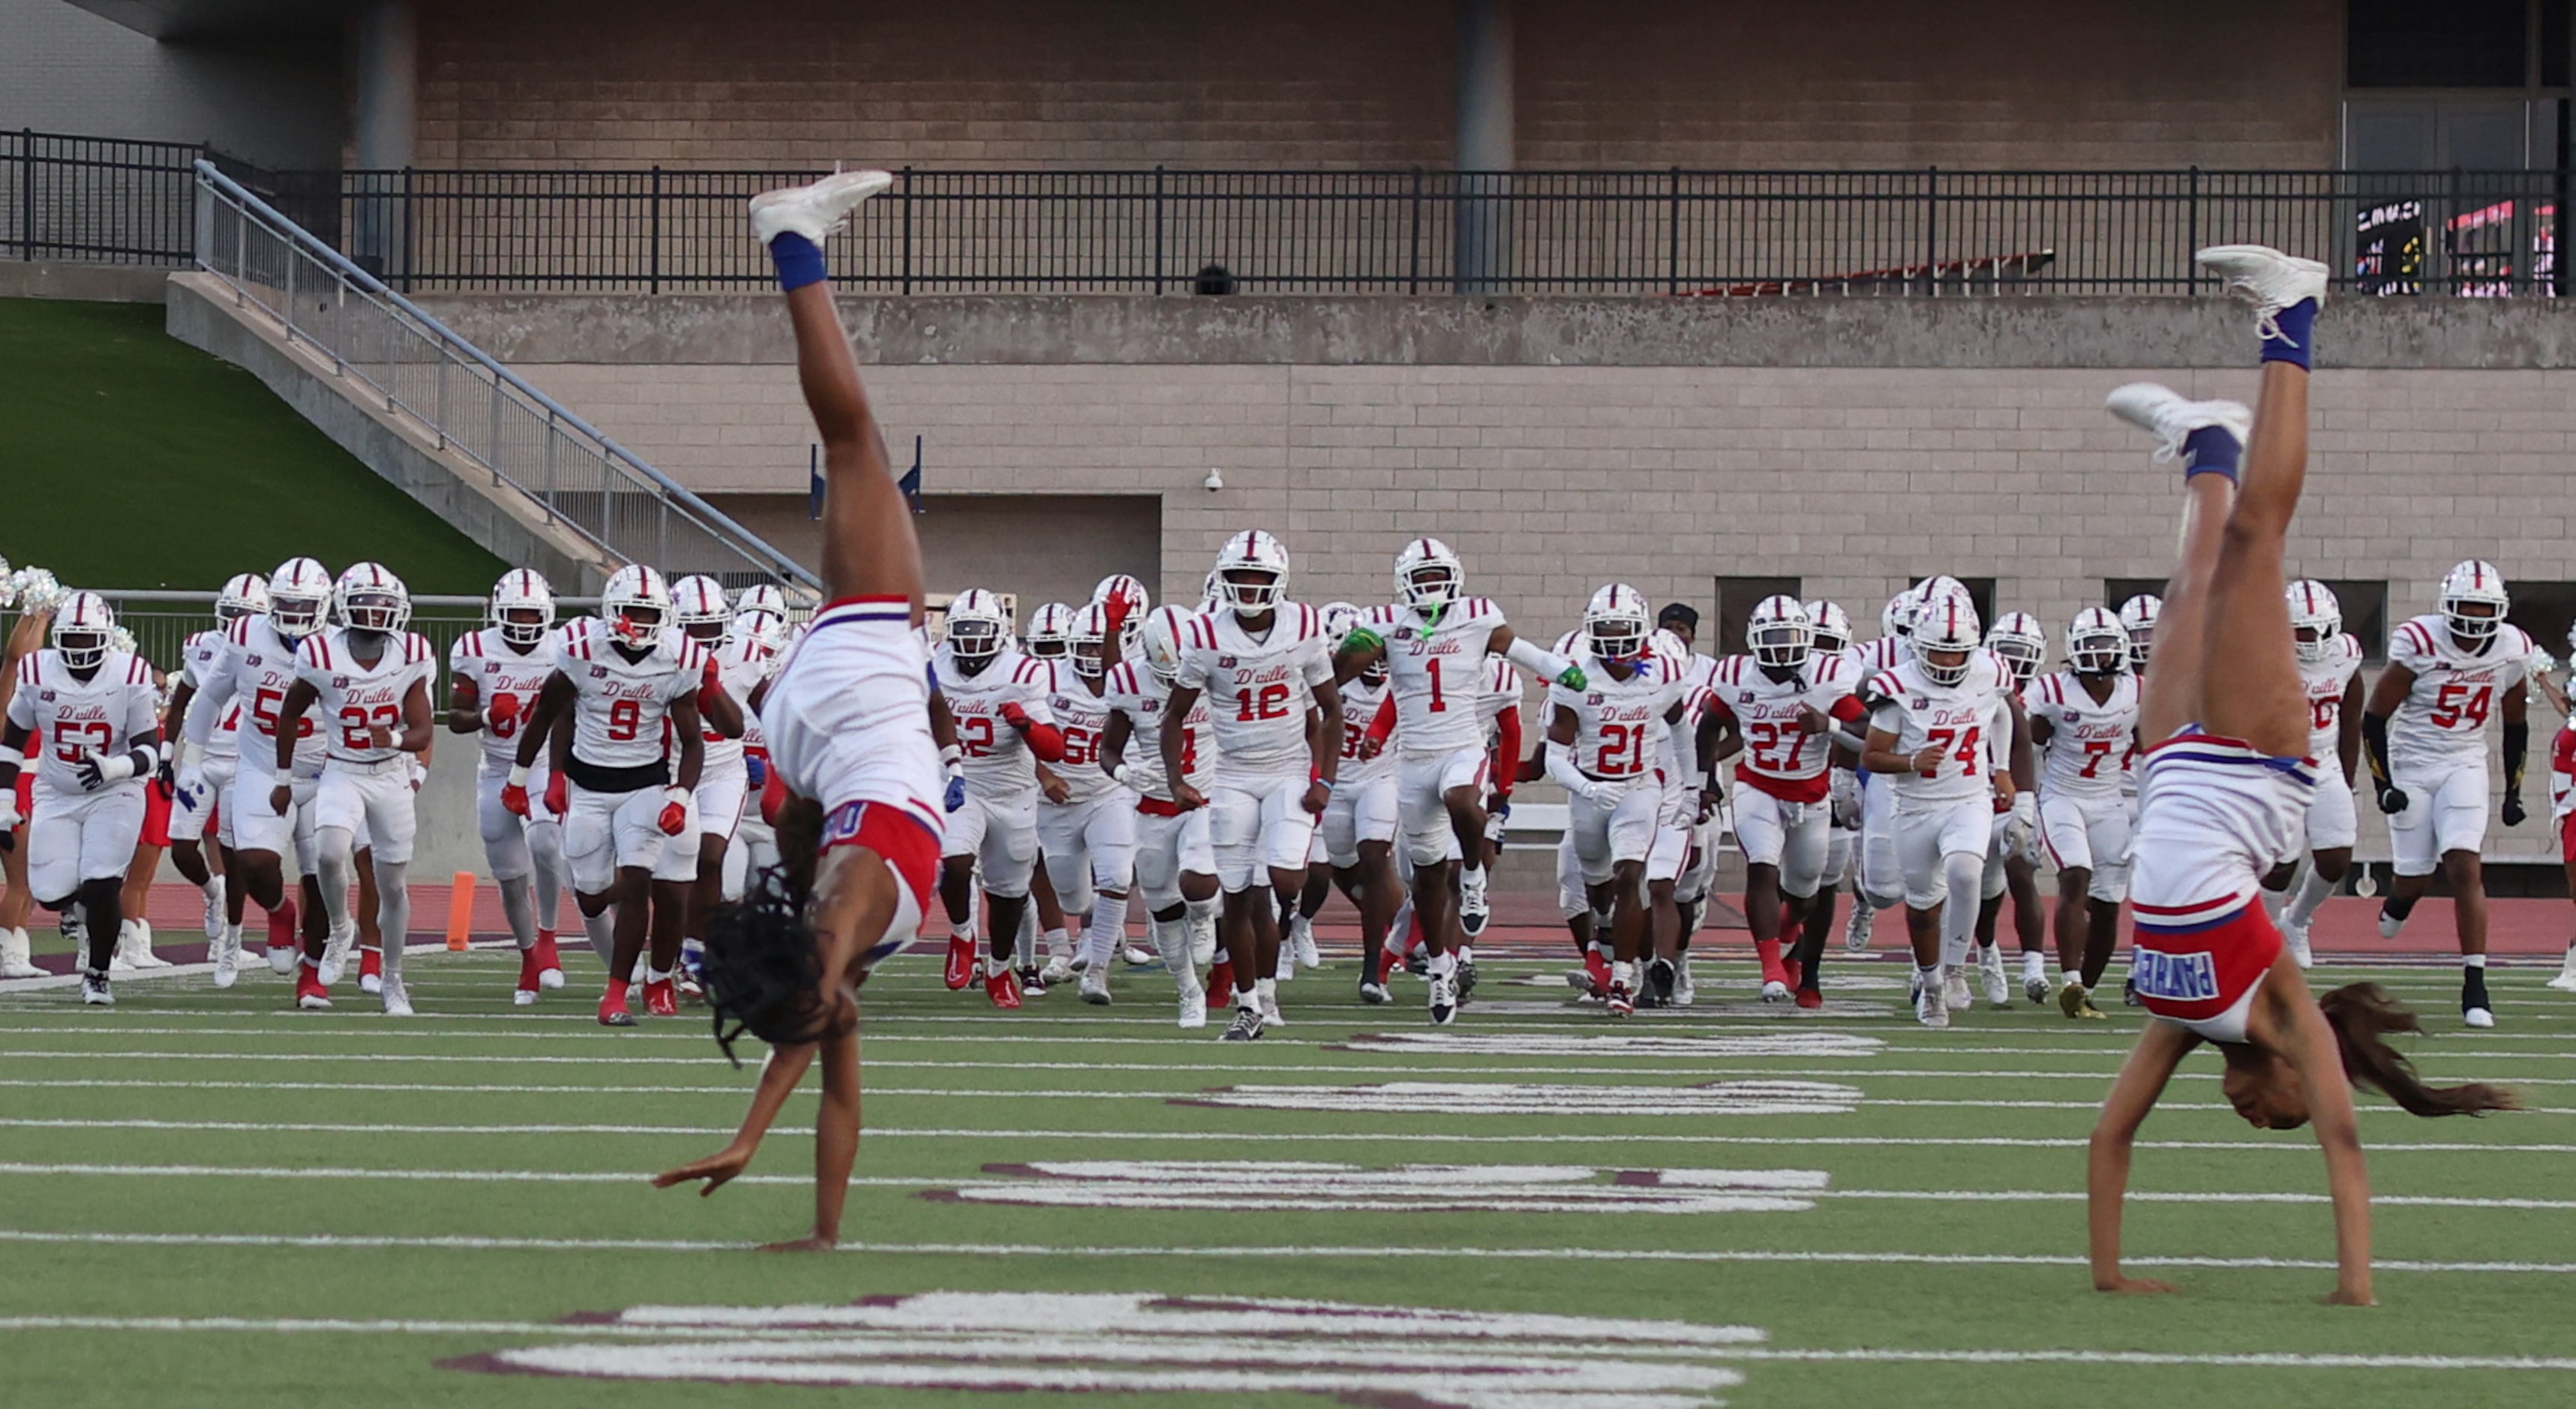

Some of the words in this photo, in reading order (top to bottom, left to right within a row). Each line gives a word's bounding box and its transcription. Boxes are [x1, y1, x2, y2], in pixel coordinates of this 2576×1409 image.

[345, 686, 395, 705] D'ville
[1234, 665, 1290, 686] D'ville
[1426, 657, 1447, 713] 1
[608, 699, 640, 741] 9
[1599, 705, 1651, 723] D'ville
[2430, 684, 2494, 730] 54
[53, 721, 113, 762] 53
[1597, 724, 1646, 775] 21
[1750, 722, 1810, 771] 27
[1919, 726, 1980, 779] 74
[2079, 741, 2112, 779] 7
